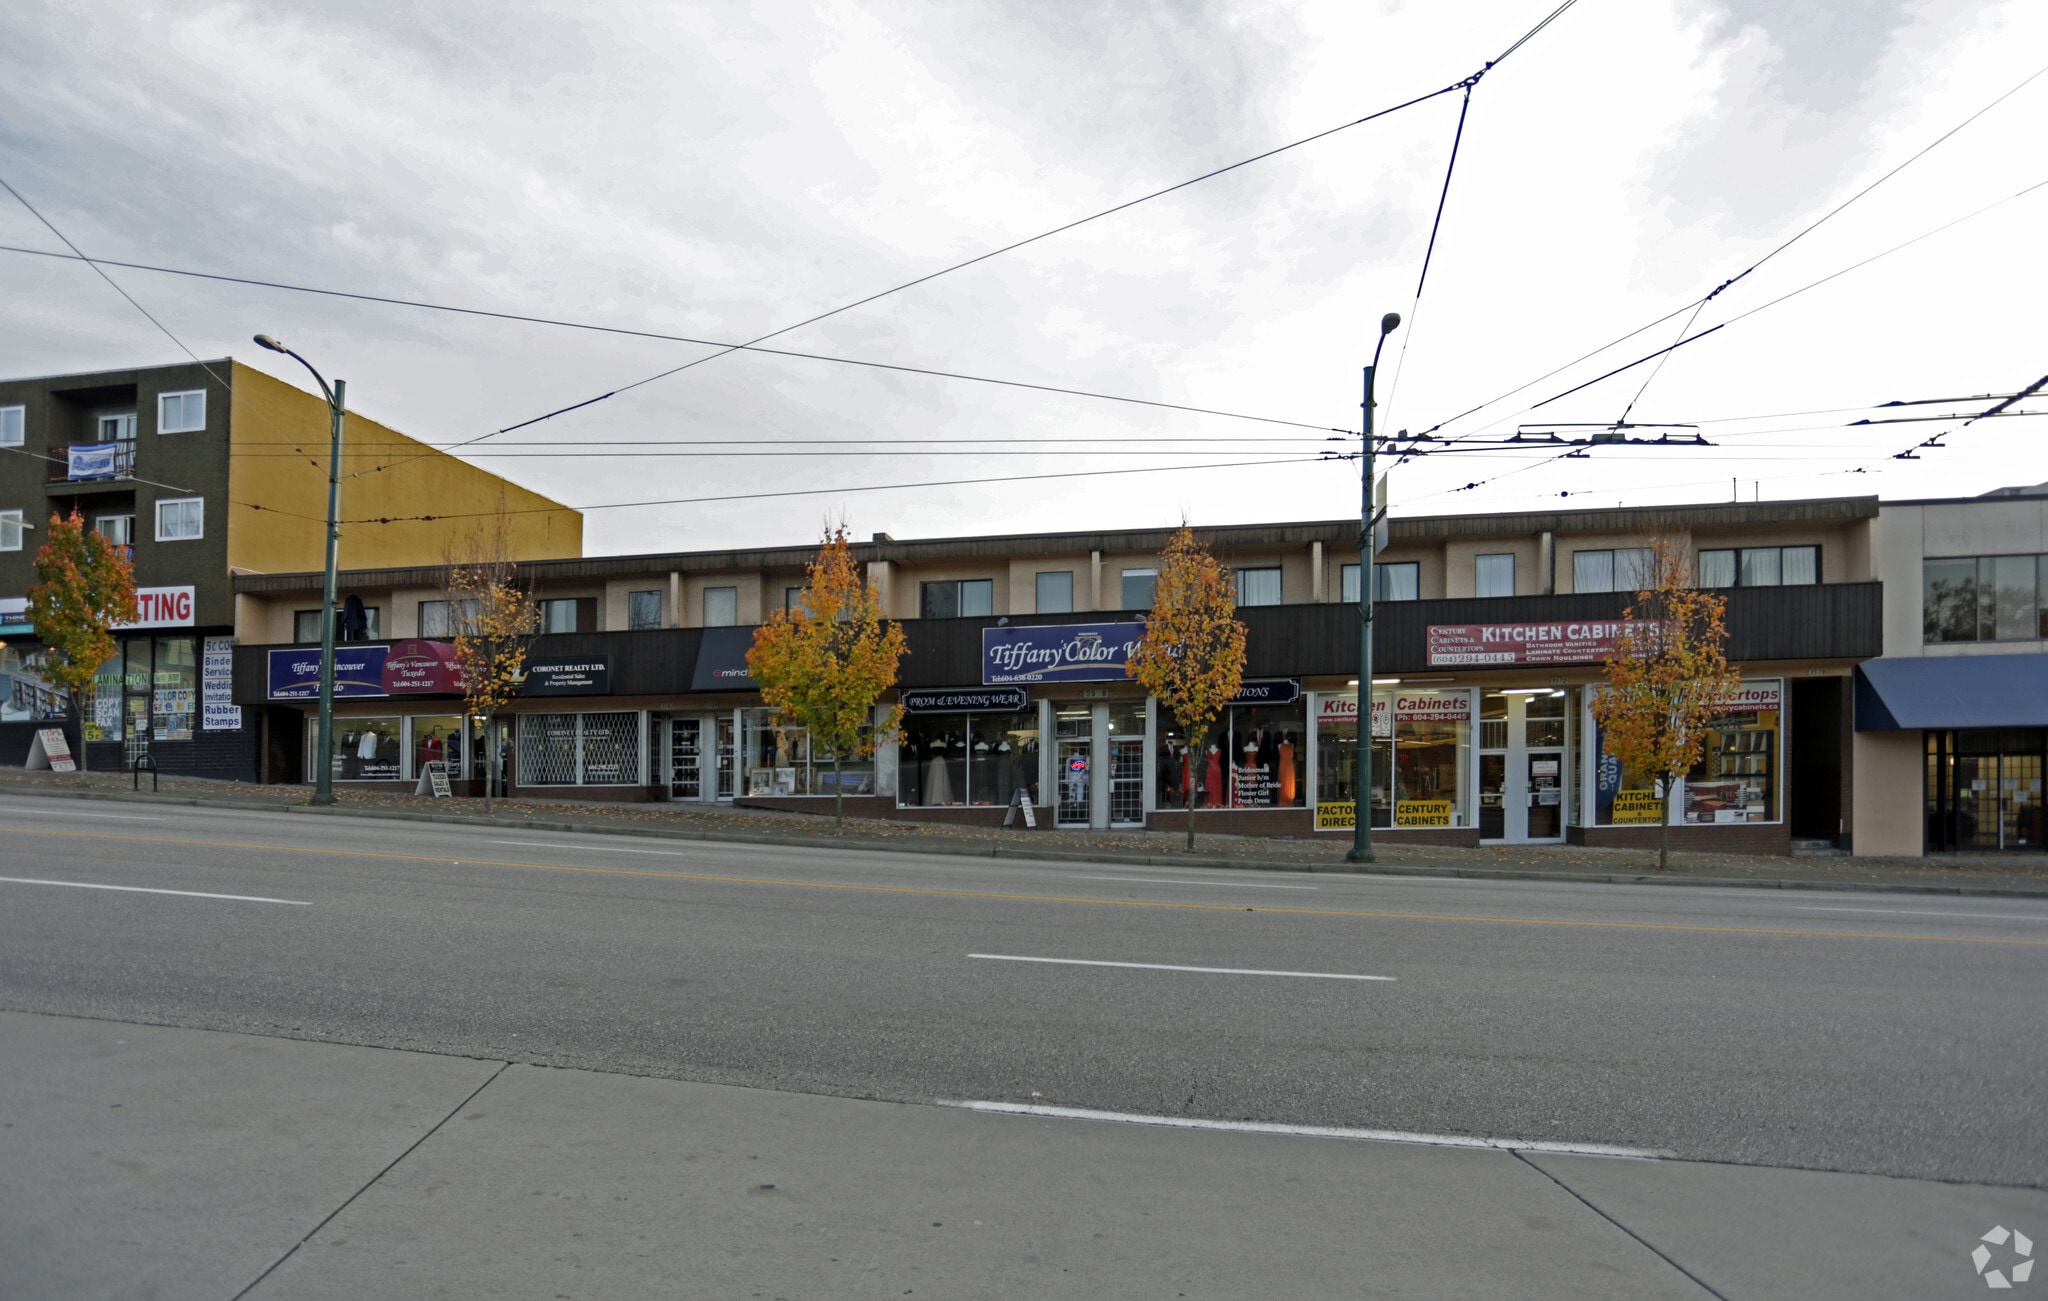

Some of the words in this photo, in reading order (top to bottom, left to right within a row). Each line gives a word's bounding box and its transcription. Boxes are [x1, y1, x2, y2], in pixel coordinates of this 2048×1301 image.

[134, 592, 191, 621] TING
[1430, 627, 1466, 636] CENTURY
[1482, 626, 1562, 642] KITCHEN
[1430, 636, 1468, 645] CABINETS
[1065, 640, 1118, 661] Color
[1430, 645, 1484, 653] COUNTERTOPS
[205, 657, 231, 666] Binde
[205, 667, 232, 676] Servic
[400, 669, 426, 677] Tuxedo
[532, 665, 564, 673] CORONET
[564, 664, 590, 672] REALTY
[712, 668, 748, 678] emind
[153, 690, 177, 701] COLOR
[178, 689, 196, 700] COPY
[205, 692, 231, 700] Invitatio
[95, 699, 120, 708] COPY
[910, 697, 936, 707] PROM
[946, 695, 991, 707] EVENING
[990, 694, 1021, 705] WEAR
[1397, 697, 1468, 710] Cabinets
[205, 705, 240, 714] Rubber
[1323, 700, 1386, 713] Kitcen
[95, 708, 120, 717] SCAN
[95, 717, 113, 727] FAX
[205, 717, 239, 727] Stamps
[1318, 716, 1357, 724] www.century
[1616, 792, 1661, 802] KITCHE
[1398, 804, 1448, 814] CENTURY
[1321, 817, 1356, 826] DIREC
[1396, 815, 1450, 826] CABINETS
[1613, 816, 1661, 824] COUNTERTOP
